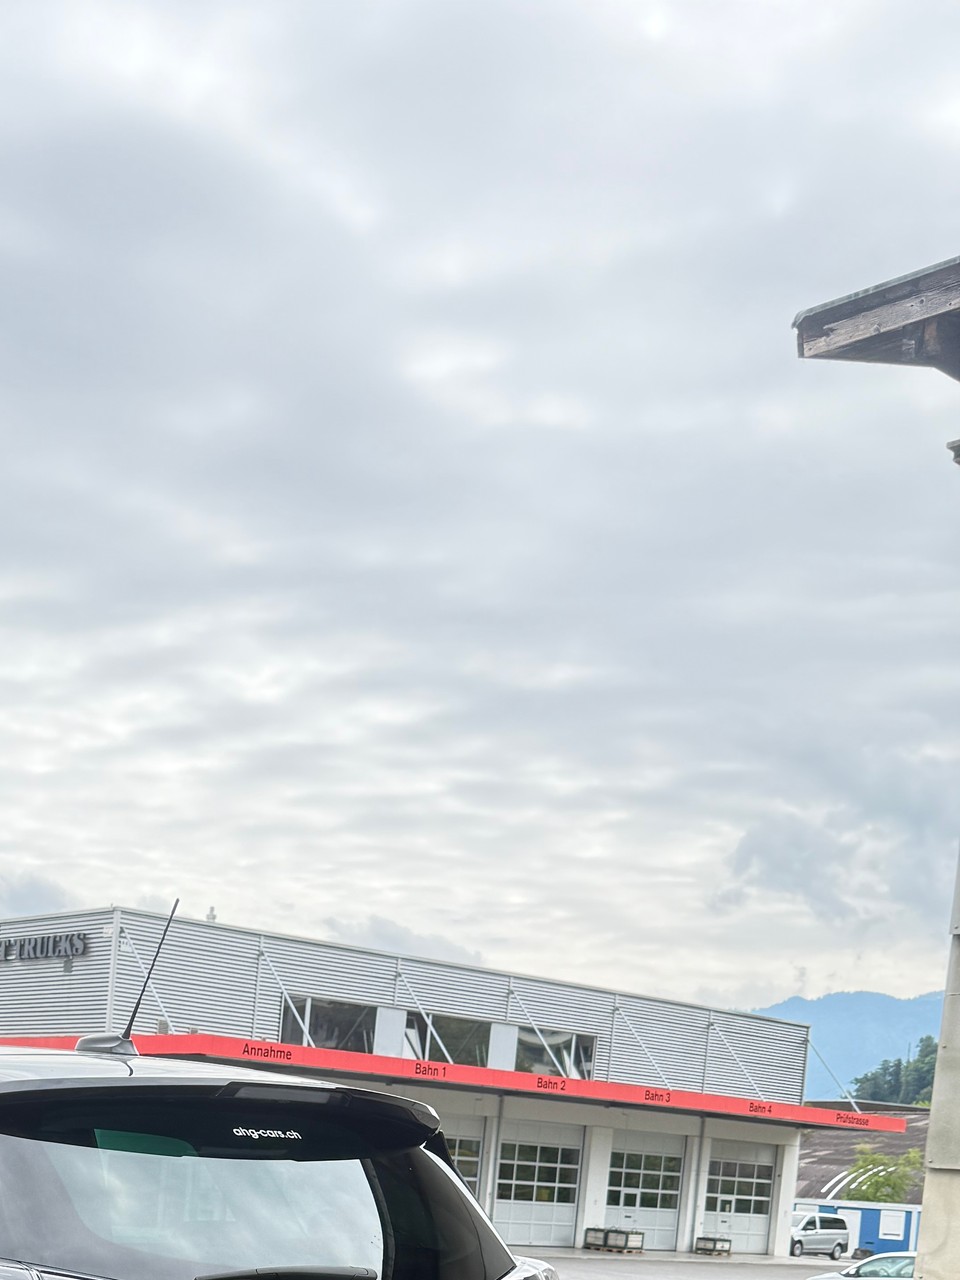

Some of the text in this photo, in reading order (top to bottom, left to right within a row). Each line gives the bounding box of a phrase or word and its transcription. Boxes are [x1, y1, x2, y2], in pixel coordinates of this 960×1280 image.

[12, 933, 86, 960] TRUCKS
[242, 1043, 292, 1061] Annahme
[414, 1063, 446, 1078] Bahn 1
[536, 1077, 566, 1091] Bahn 2
[644, 1090, 671, 1103] Bahn 3
[749, 1102, 772, 1114] Bahn 4
[836, 1113, 869, 1127] Prüfstrasse
[233, 1126, 302, 1140] ahg-cars.ch
